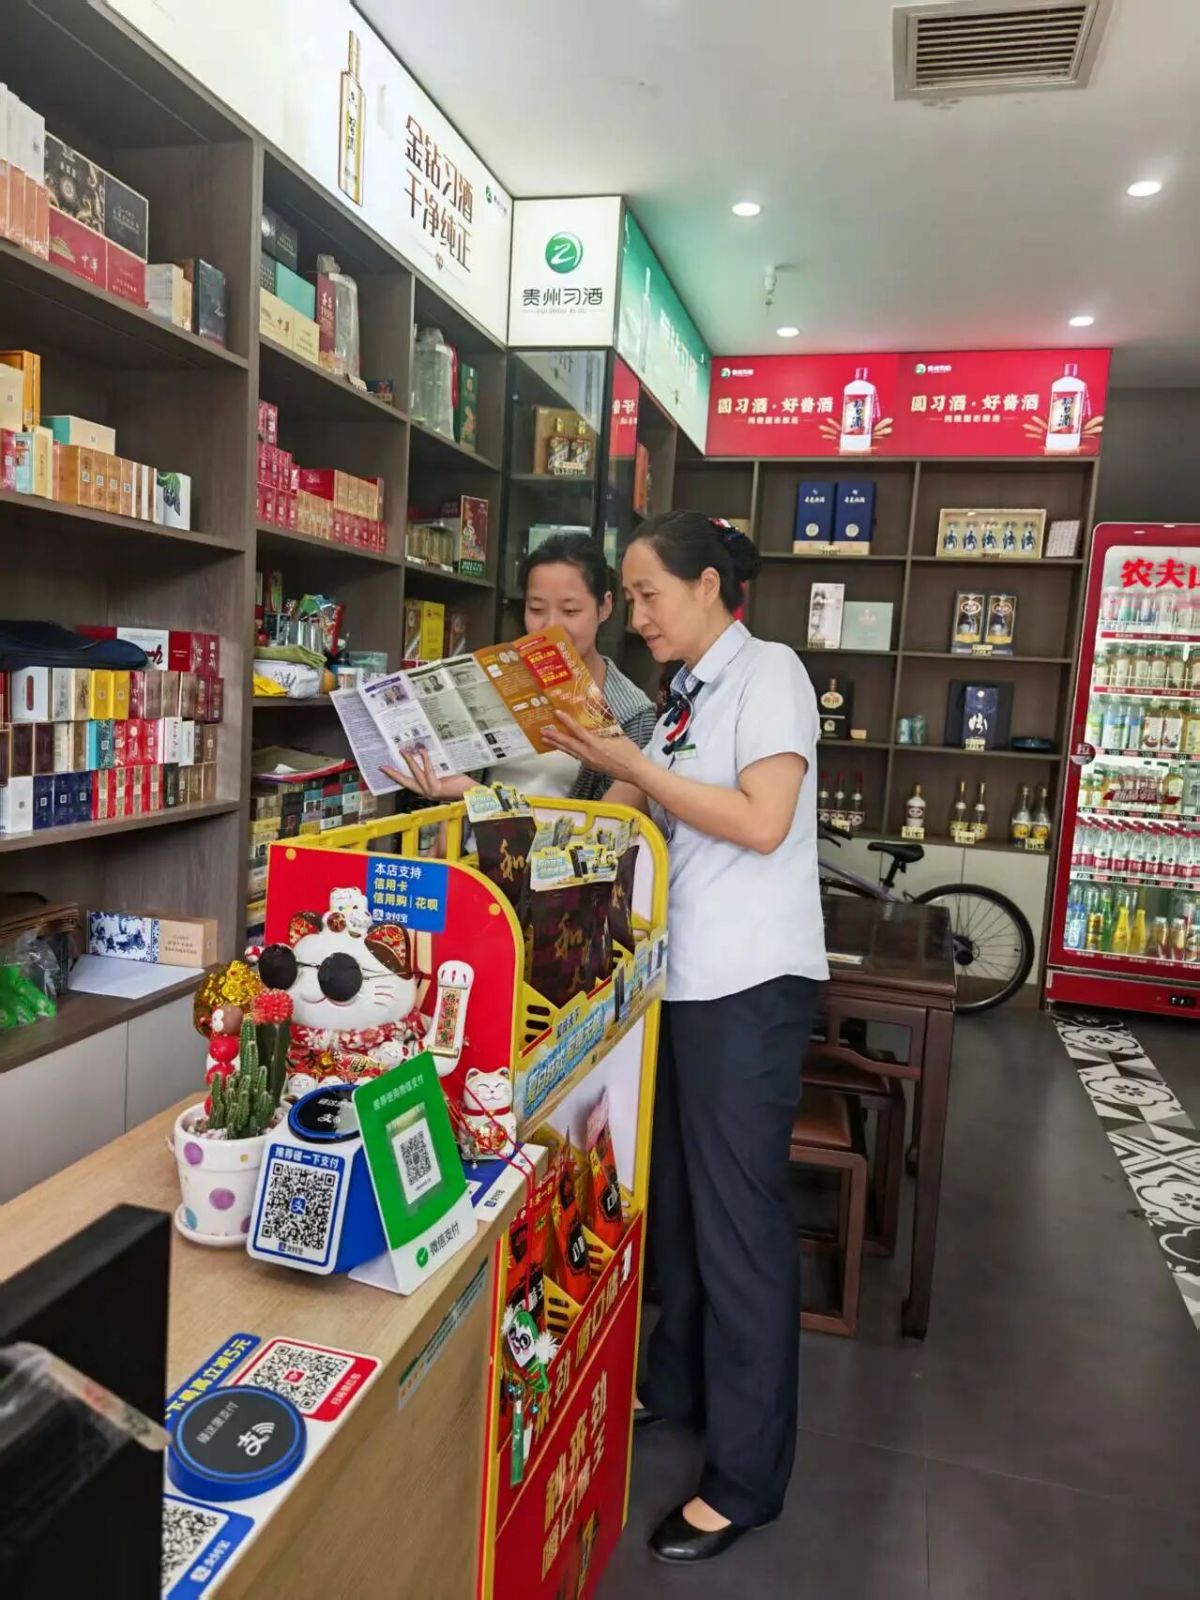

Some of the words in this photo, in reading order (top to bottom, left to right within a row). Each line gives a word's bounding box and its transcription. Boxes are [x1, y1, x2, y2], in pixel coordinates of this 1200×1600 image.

[405, 115, 474, 224] 金钻习酒
[404, 169, 471, 273] 干净纯正
[522, 288, 603, 306] 贵州习酒
[374, 862, 422, 880] 本店支持
[374, 877, 409, 892] 信用卡
[415, 897, 439, 912] 花呗
[385, 911, 409, 924] 支付宝
[429, 1220, 460, 1256] 微信支付
